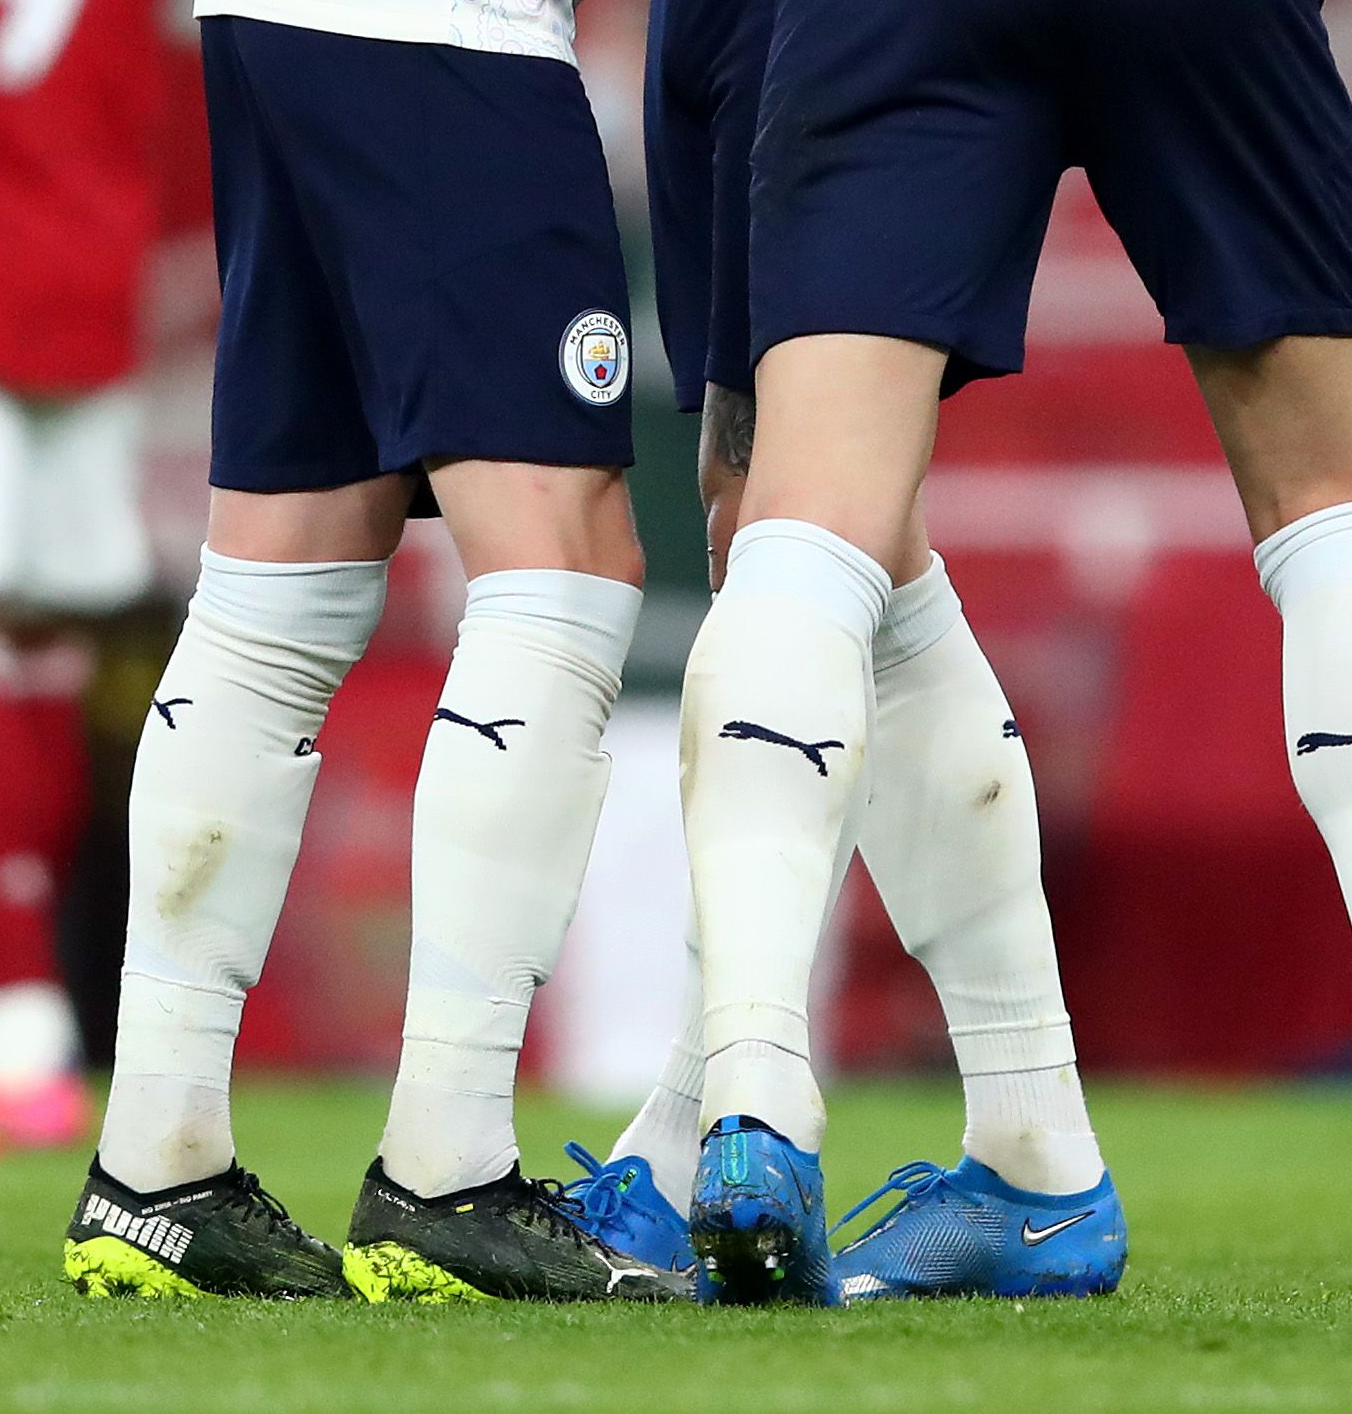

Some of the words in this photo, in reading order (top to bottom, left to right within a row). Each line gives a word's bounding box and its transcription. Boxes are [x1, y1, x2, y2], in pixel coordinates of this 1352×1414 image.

[569, 316, 626, 347] MANCHESTER
[590, 390, 613, 400] CITY
[80, 1193, 195, 1265] PUMA
